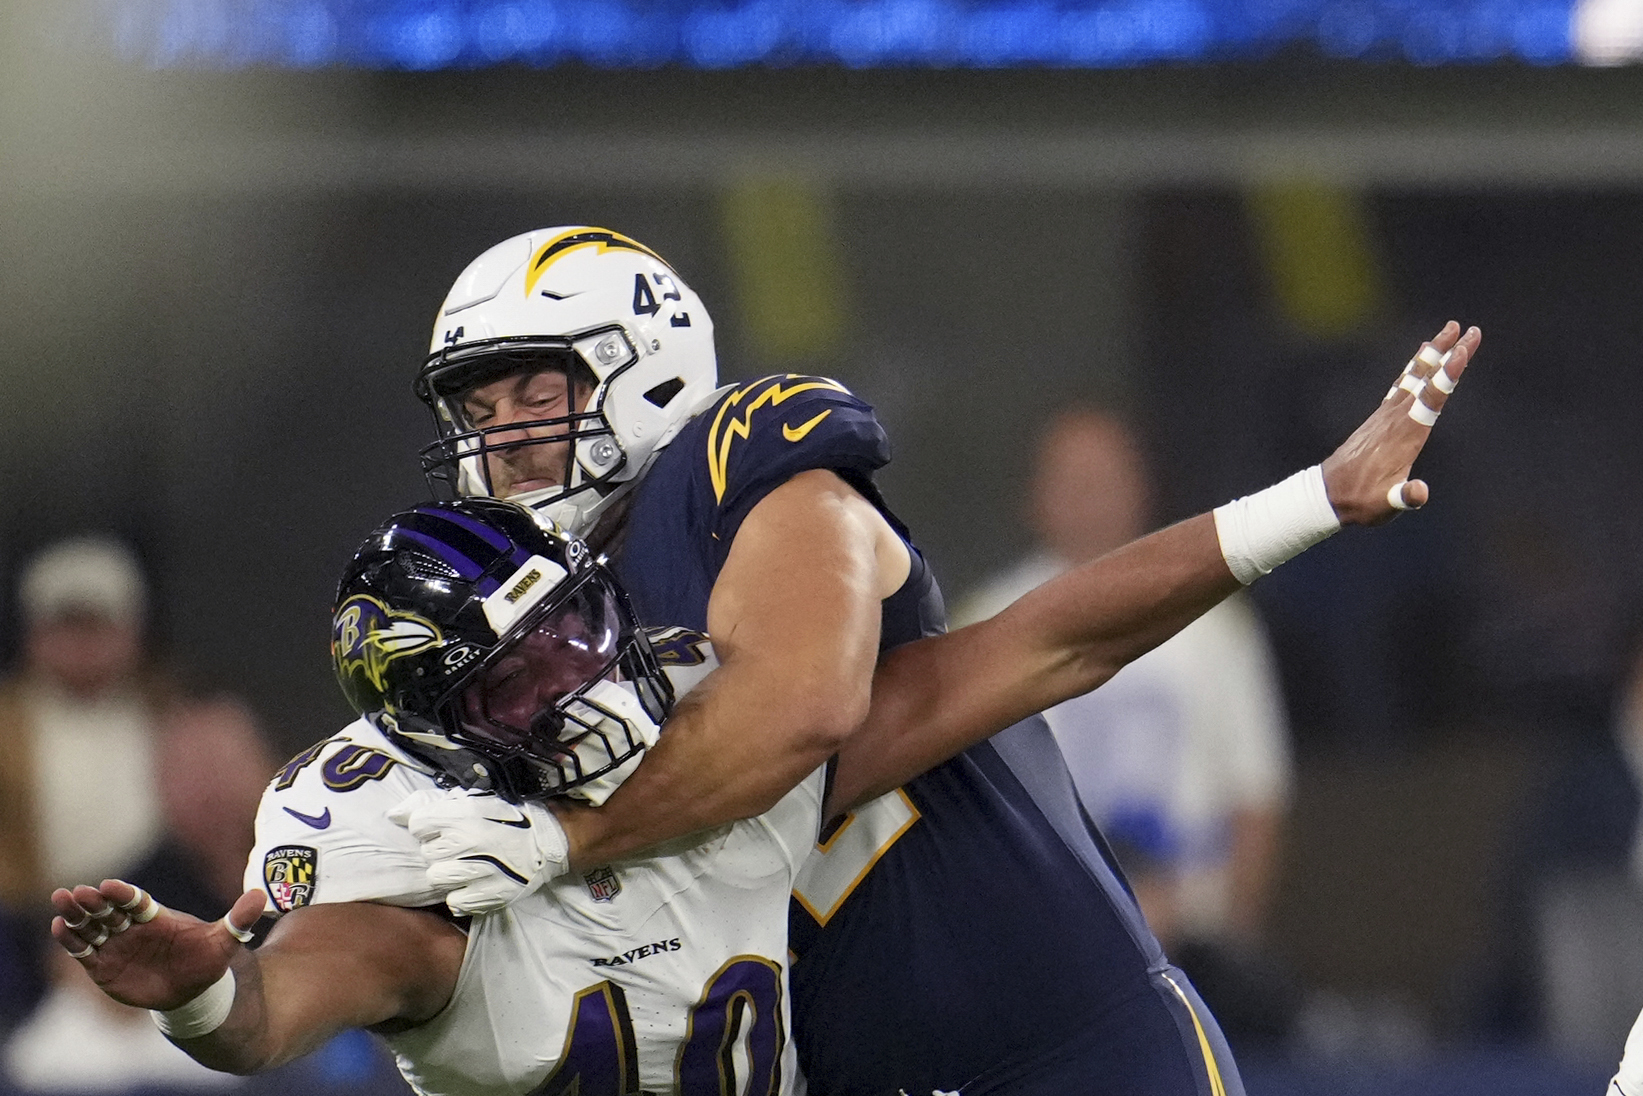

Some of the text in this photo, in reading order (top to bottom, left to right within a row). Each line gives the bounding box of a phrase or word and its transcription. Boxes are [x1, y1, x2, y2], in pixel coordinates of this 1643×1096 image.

[504, 569, 541, 604] RAVENS
[444, 649, 480, 675] OAKLEY
[267, 850, 311, 862] RAVENS
[590, 938, 682, 967] RAVENS
